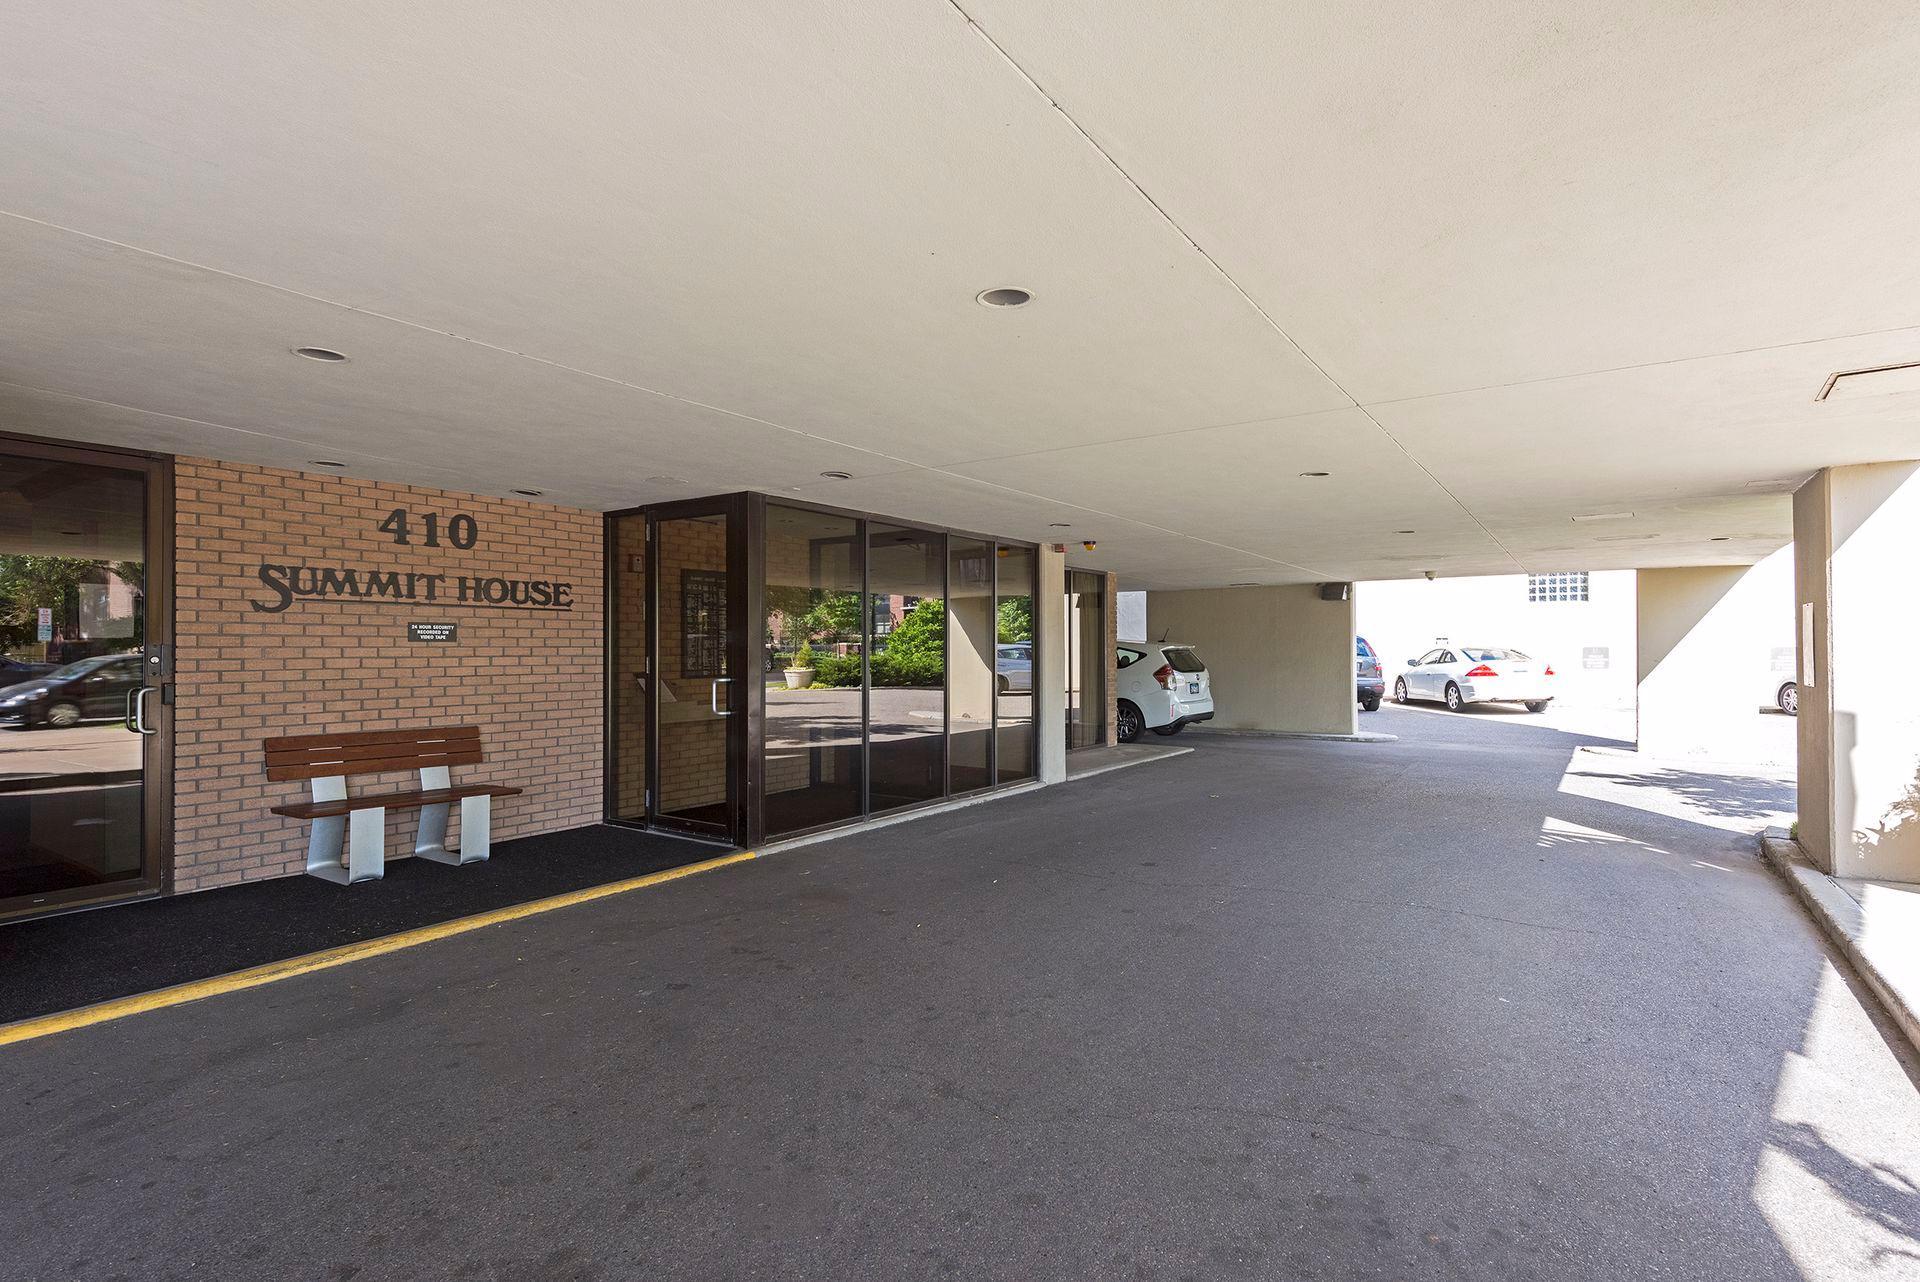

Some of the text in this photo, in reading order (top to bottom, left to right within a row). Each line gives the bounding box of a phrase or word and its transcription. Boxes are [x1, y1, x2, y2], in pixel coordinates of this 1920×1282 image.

[379, 508, 478, 550] 410
[250, 563, 575, 613] SUMMIT HOUSE
